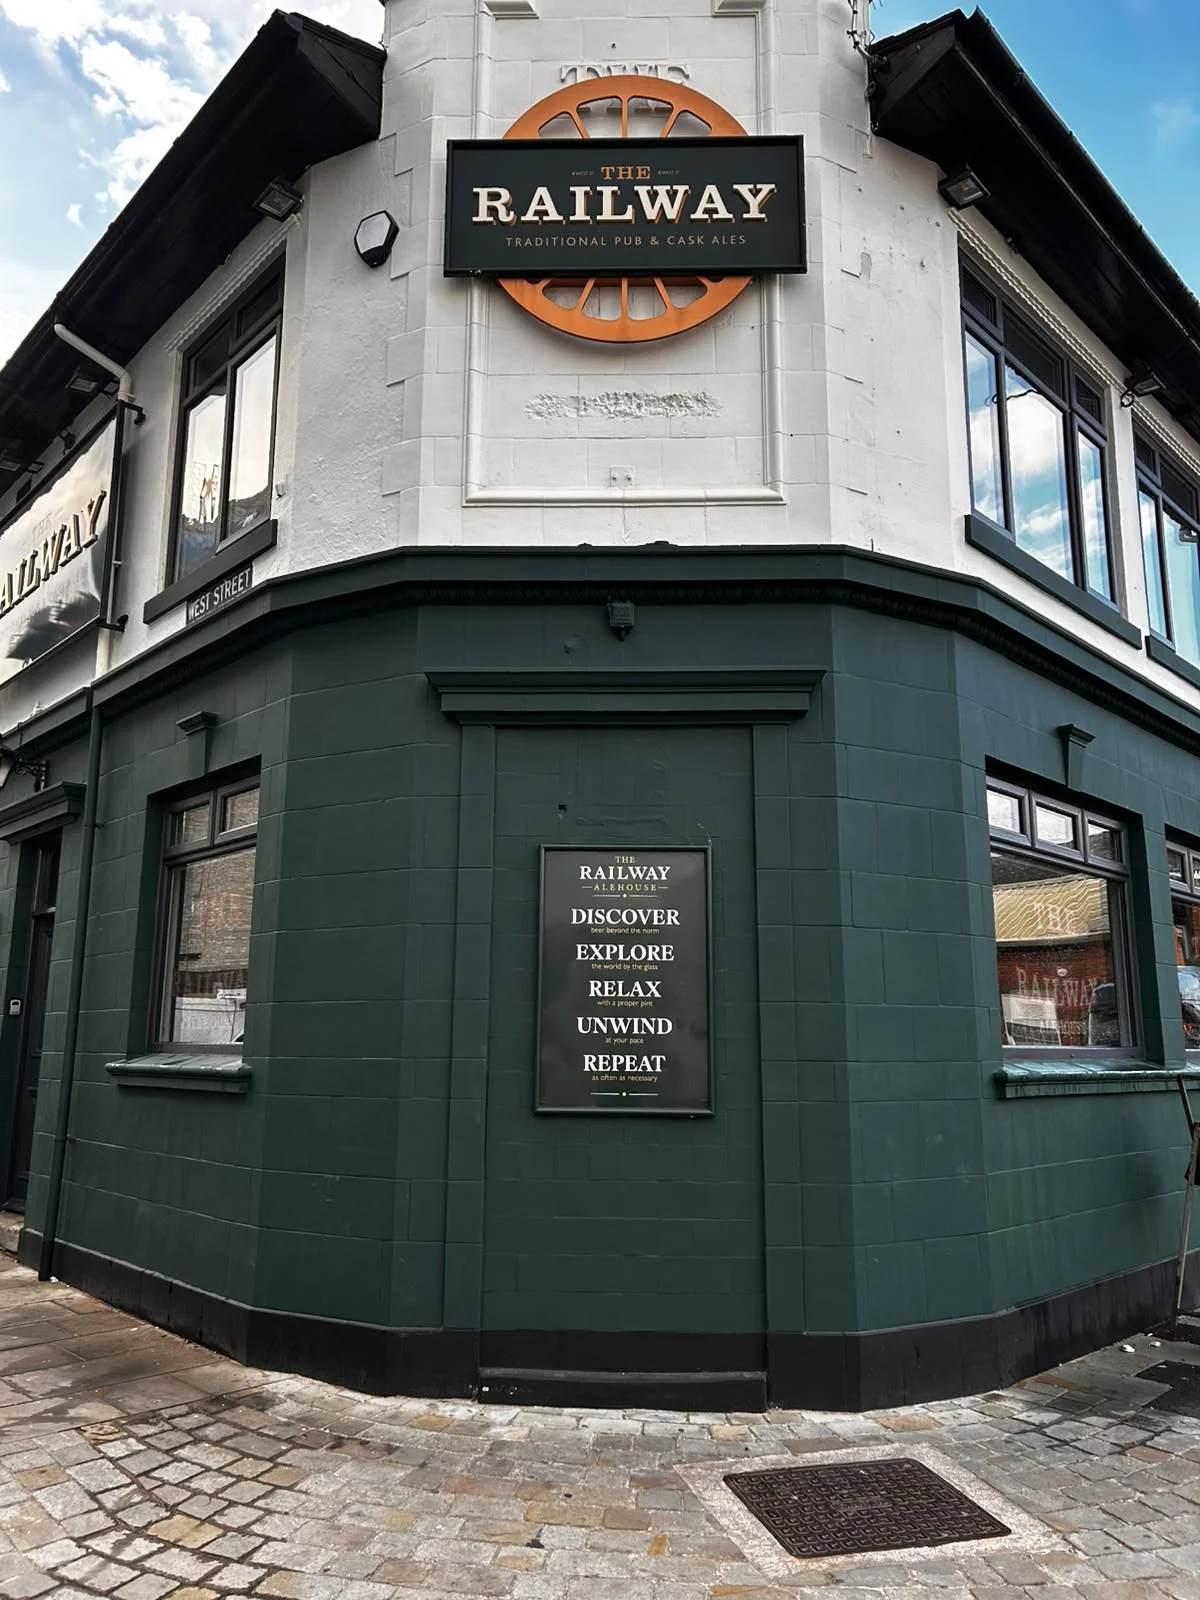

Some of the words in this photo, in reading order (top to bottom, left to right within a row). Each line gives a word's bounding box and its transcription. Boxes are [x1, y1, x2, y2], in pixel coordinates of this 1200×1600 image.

[601, 166, 651, 180] THE
[472, 184, 777, 225] RAILWAY
[506, 237, 607, 247] TRADITIONAL
[615, 236, 642, 246] PUB
[650, 236, 659, 245] &
[667, 236, 704, 245] CASK
[711, 235, 746, 245] ALES
[188, 592, 211, 620] WEST
[213, 568, 251, 605] STREET
[614, 856, 636, 864] THE
[579, 865, 671, 880] RAILWAY
[593, 883, 657, 892] ALEHOUSE
[570, 908, 681, 926] DISCOVER
[606, 927, 629, 935] beyond
[575, 943, 675, 961] EXPLORE
[623, 963, 630, 971] by
[643, 964, 659, 972] glass
[588, 980, 662, 998] RELAX
[1013, 964, 1100, 1009] RAILWAY
[576, 1016, 673, 1035] UNWIND
[583, 1054, 666, 1073] REPEAT
[627, 1075, 658, 1083] necessary
